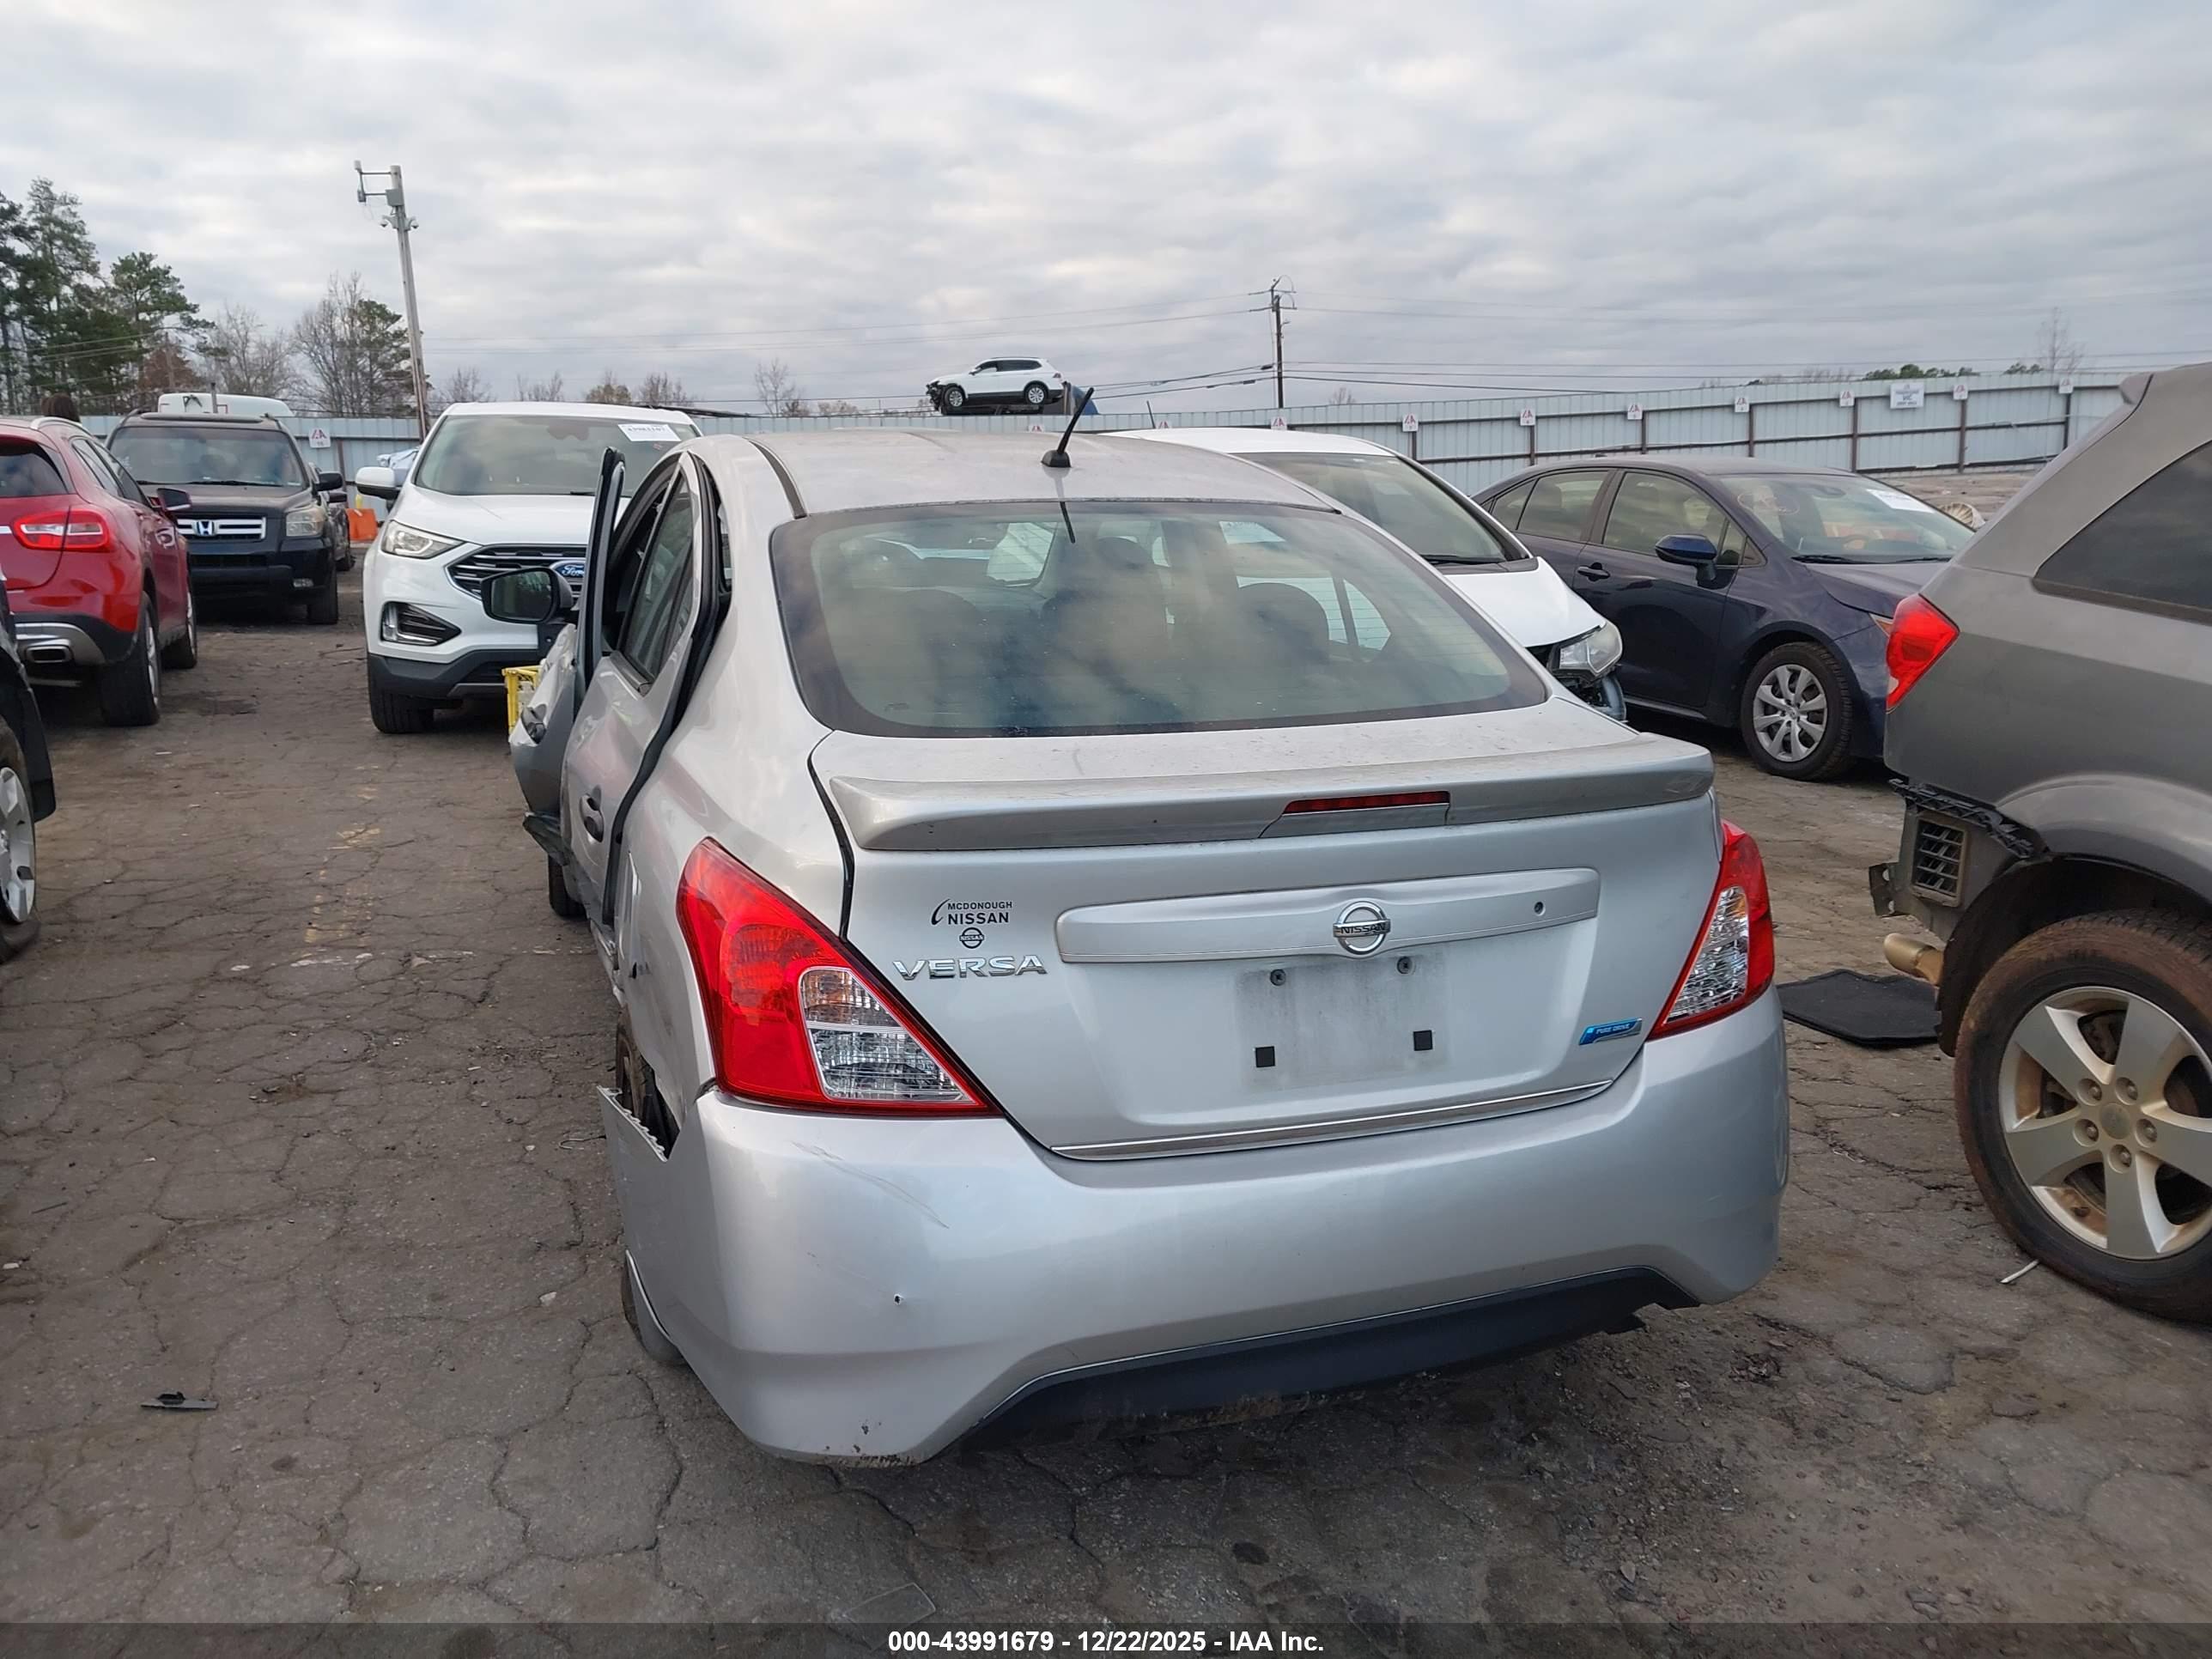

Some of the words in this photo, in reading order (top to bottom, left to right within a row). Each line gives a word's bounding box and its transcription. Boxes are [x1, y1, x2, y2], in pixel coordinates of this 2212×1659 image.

[947, 901, 1013, 910] MCDONOUGH
[947, 912, 1010, 925] NISSAN
[1340, 922, 1386, 934] NISSAN
[892, 954, 1048, 981] VERSA
